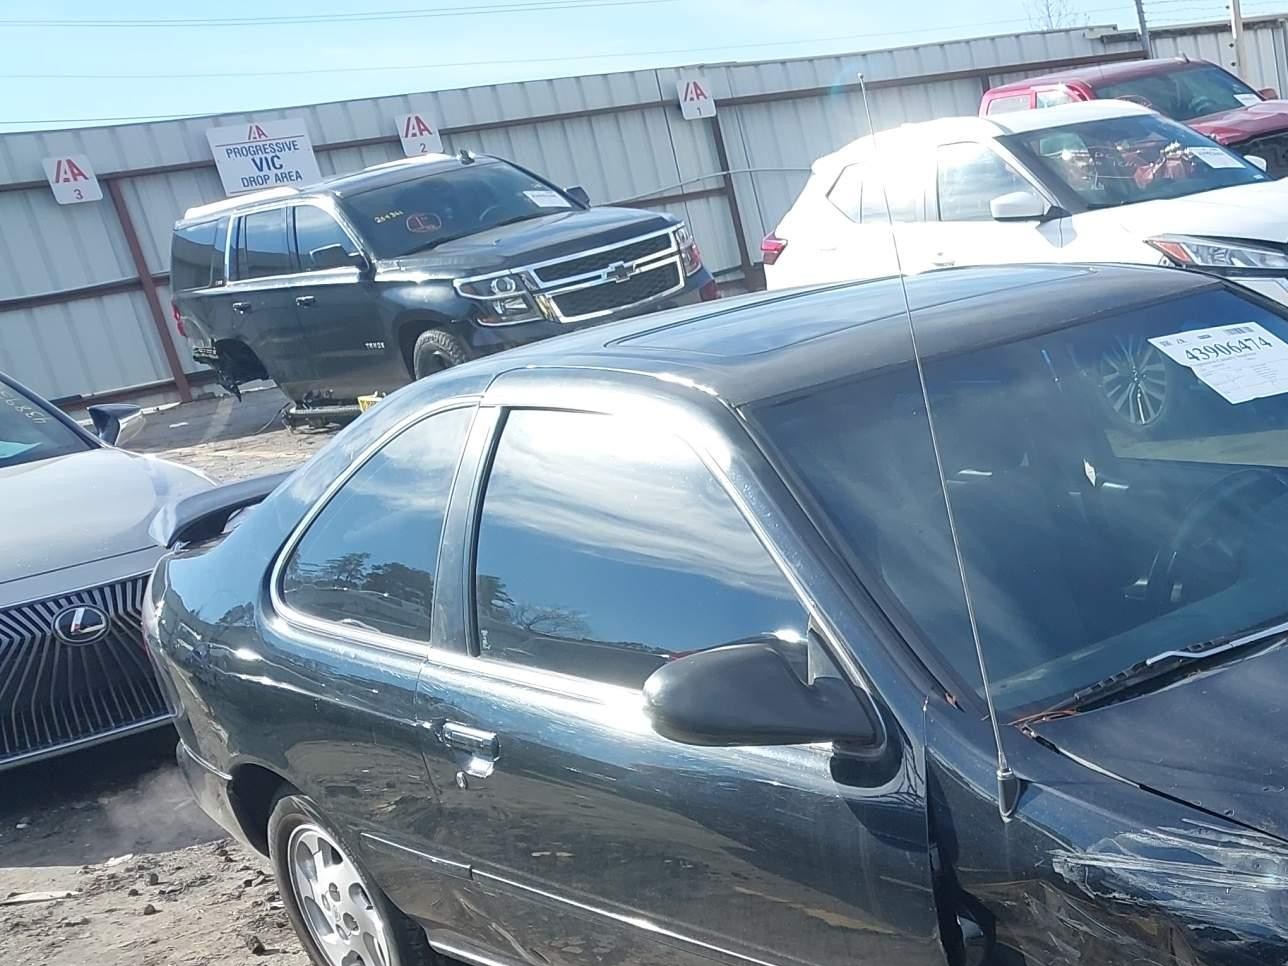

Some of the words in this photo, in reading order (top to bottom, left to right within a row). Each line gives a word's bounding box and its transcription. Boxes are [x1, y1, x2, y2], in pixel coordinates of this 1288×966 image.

[225, 140, 300, 159] PROGRESSIVE
[420, 143, 427, 153] 2
[251, 154, 284, 172] VIC
[241, 174, 272, 188] DROP
[274, 170, 304, 185] AREA
[73, 188, 84, 200] 3
[1185, 335, 1273, 362] 43906474
